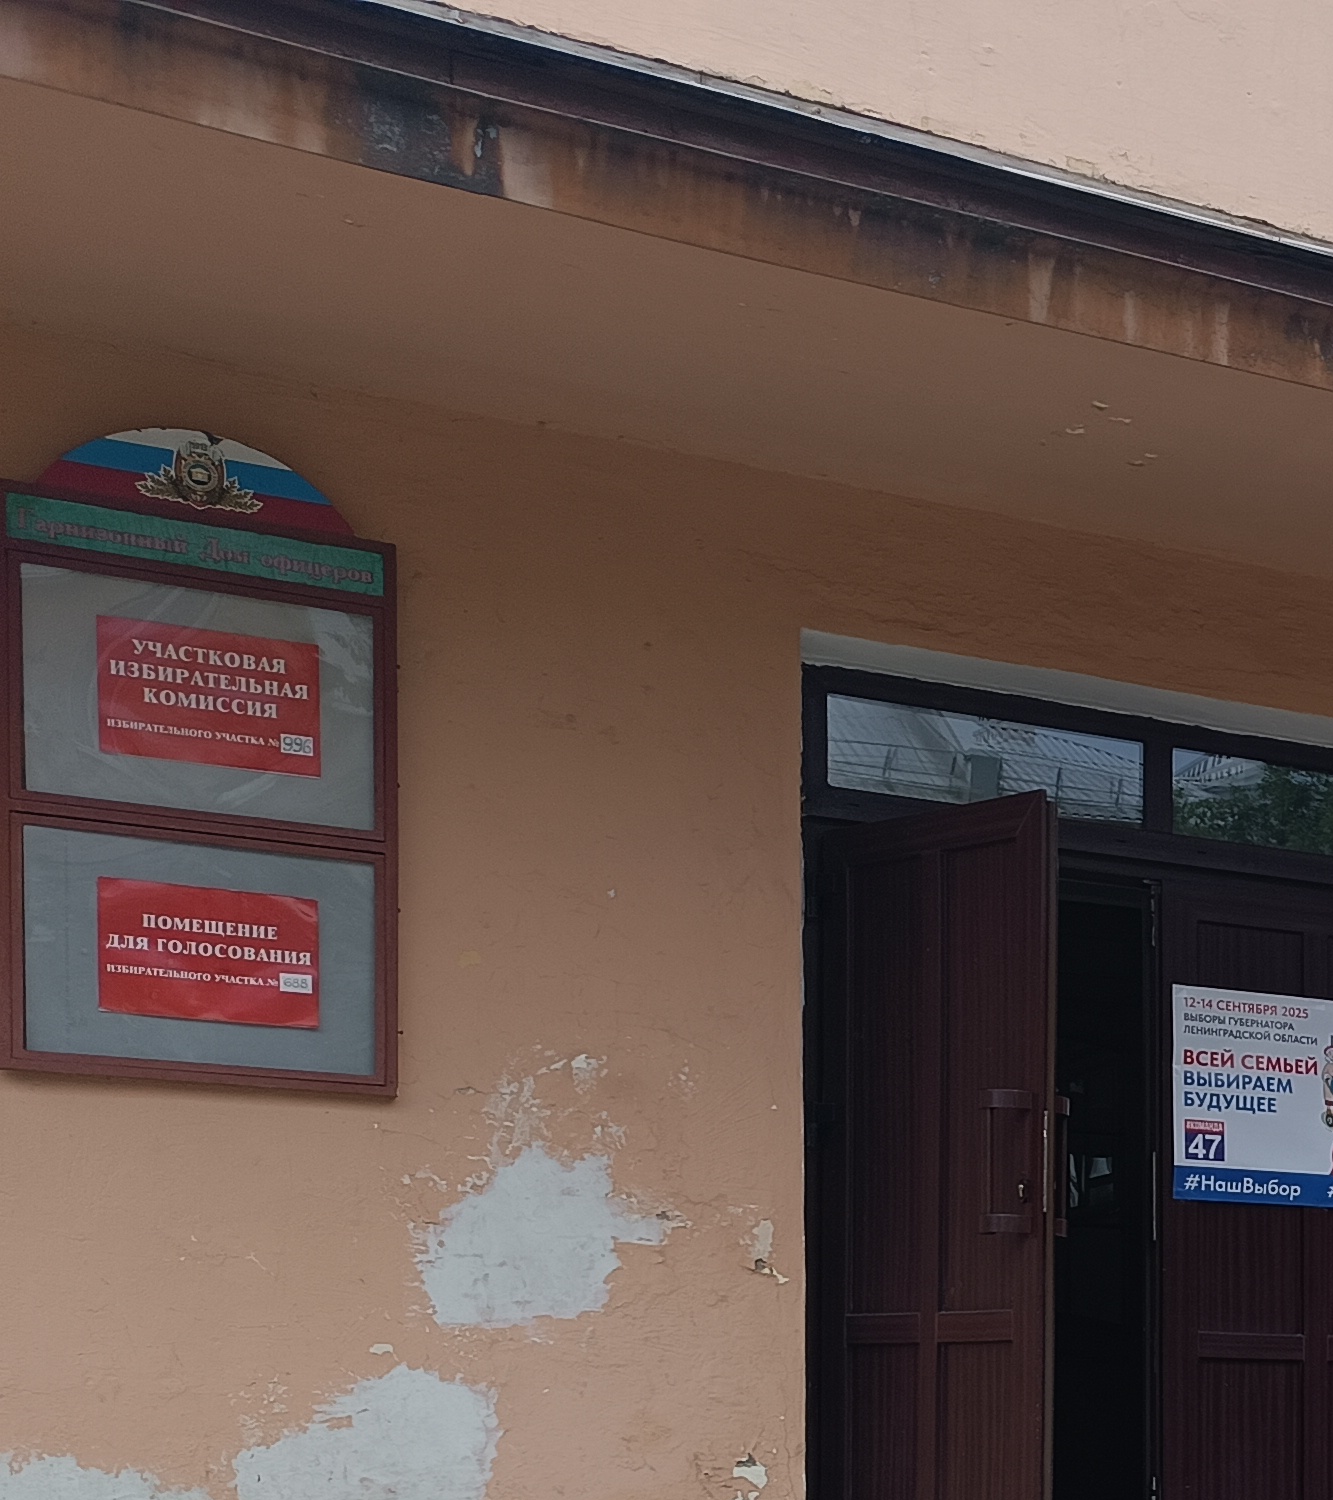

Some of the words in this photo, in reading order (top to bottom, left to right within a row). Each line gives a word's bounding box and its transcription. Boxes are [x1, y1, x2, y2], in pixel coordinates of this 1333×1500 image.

[17, 507, 188, 554] Гарнизонный
[199, 537, 250, 565] Дом
[260, 553, 374, 585] офицеров
[131, 639, 287, 674] УЧАСТКОВАЯ
[109, 659, 310, 700] ИЗБИРАТЕЛЬНАЯ
[142, 687, 278, 719] КОМИССИЯ
[106, 718, 213, 740] ИЗБИРАТЕЛЬНОГО
[214, 731, 266, 746] УЧАСТКА
[282, 735, 312, 754] 996
[141, 913, 279, 940] ПОМЕЩЕНИЕ
[105, 934, 150, 951] ДЛЯ
[157, 938, 312, 966] ГОЛОСОВАНИЯ
[106, 963, 211, 982] ИЗБИРАТЕЛЬНОГО
[214, 973, 264, 986] УЧАСТКА
[1183, 996, 1213, 1010] 12-14
[1216, 999, 1278, 1016] СЕНТЯБРЯ
[1281, 1006, 1309, 1019] 2025
[1183, 1012, 1226, 1025] ВЫБОРЫ
[1228, 1016, 1295, 1031] ГУБЕРНАТОРА
[1183, 1025, 1271, 1041] ЛЕНИНГРАДСКОЙ
[1273, 1033, 1318, 1046] ОБЛАСТИ
[1183, 1048, 1235, 1069] ВСЕЙ
[1241, 1054, 1318, 1075] СЕМЬЕЙ
[1183, 1070, 1293, 1094] ВЫБИРАЕМ
[1183, 1090, 1278, 1114] БУДУЩЕЕ
[1188, 1133, 1222, 1160] 47
[1183, 1173, 1301, 1201] #НашВыбор
